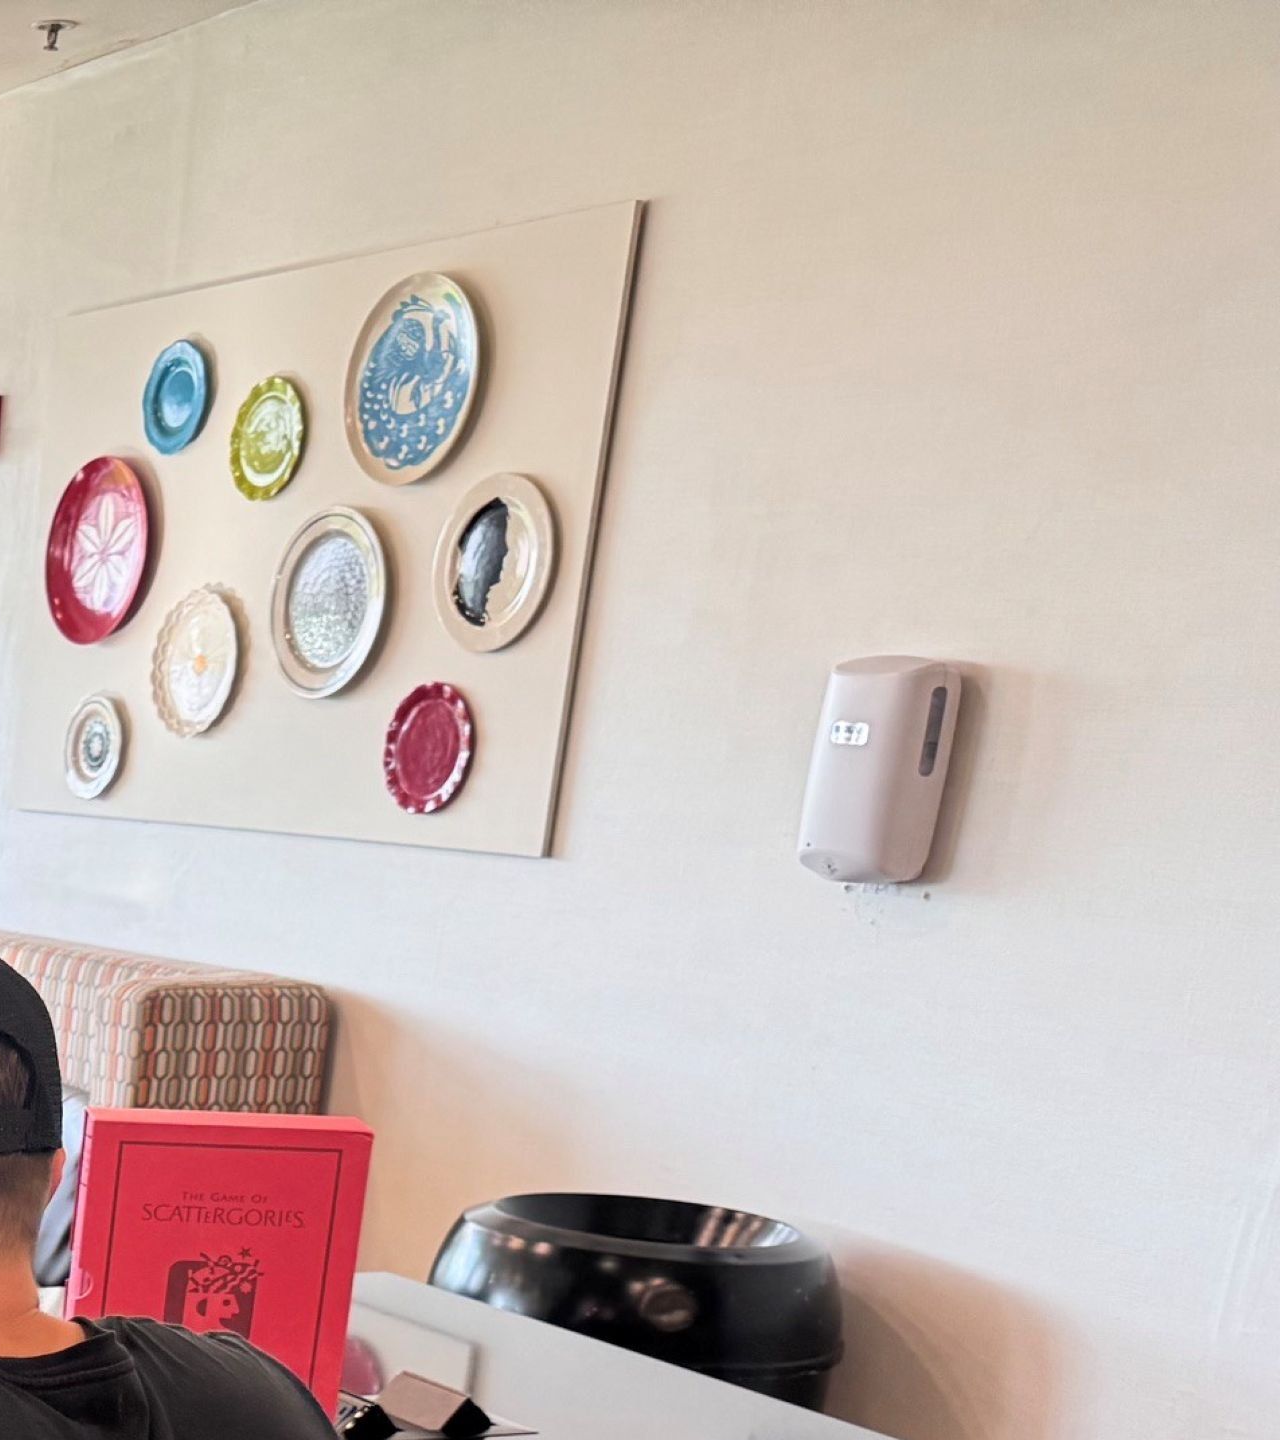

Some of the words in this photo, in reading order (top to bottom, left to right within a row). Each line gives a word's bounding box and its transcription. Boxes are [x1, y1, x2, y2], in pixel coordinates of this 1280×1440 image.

[183, 1191, 205, 1201] THE
[210, 1192, 245, 1203] GAME
[250, 1194, 269, 1204] OF
[141, 1203, 306, 1230] SCATTERGORIES
